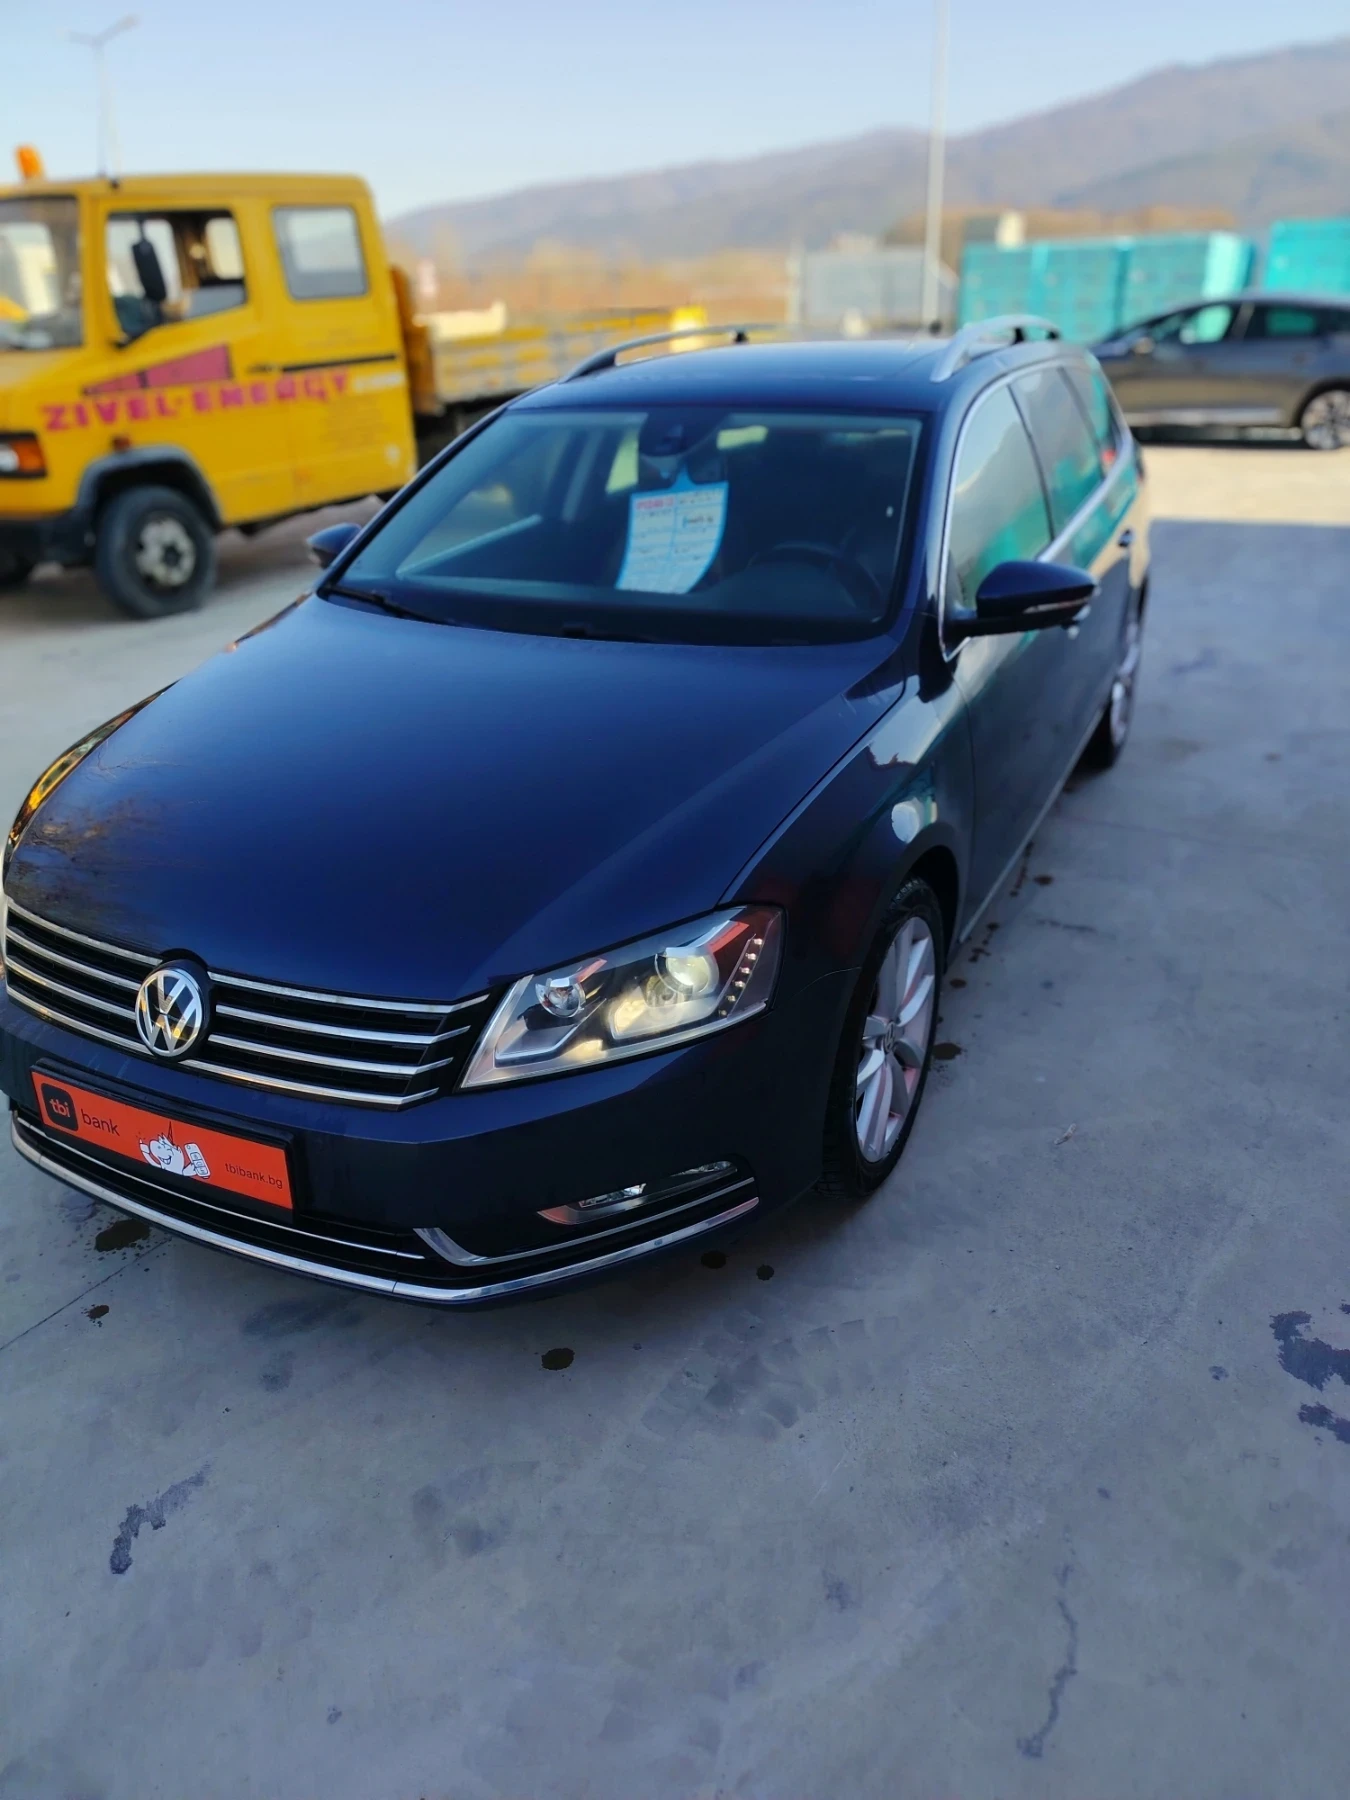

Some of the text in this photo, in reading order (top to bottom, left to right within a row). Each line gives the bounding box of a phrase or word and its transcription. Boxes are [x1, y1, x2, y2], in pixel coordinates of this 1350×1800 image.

[49, 1098, 120, 1137] tbi bank
[224, 1162, 284, 1190] tbibank.bg
